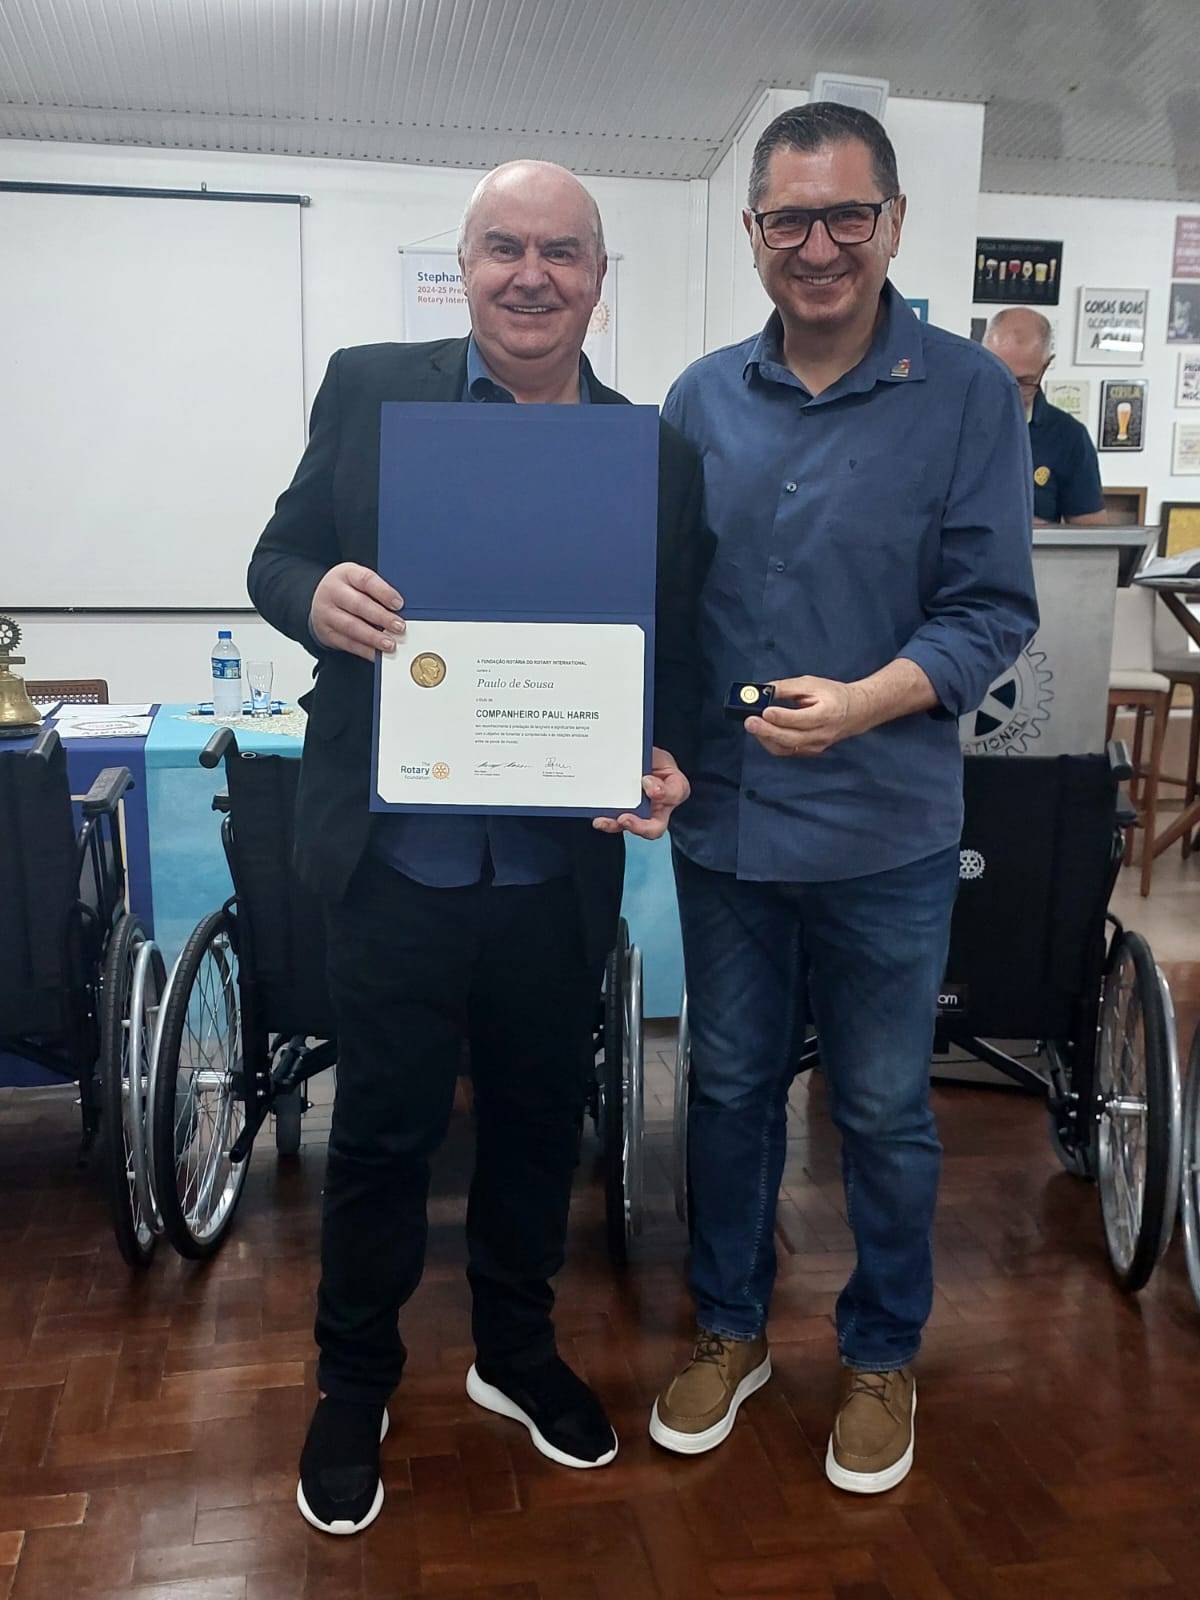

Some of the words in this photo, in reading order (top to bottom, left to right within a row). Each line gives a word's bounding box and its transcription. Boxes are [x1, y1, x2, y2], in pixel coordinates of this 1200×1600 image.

[417, 286, 447, 294] 2024-25
[417, 296, 444, 305] Rotary
[477, 678, 507, 688] Paulo
[509, 678, 521, 688] de
[523, 679, 554, 689] Sousa
[475, 709, 540, 719] COMPANHEIRO
[542, 710, 565, 720] PAUL
[567, 711, 600, 720] HARRIS
[400, 765, 430, 776] Rotary
